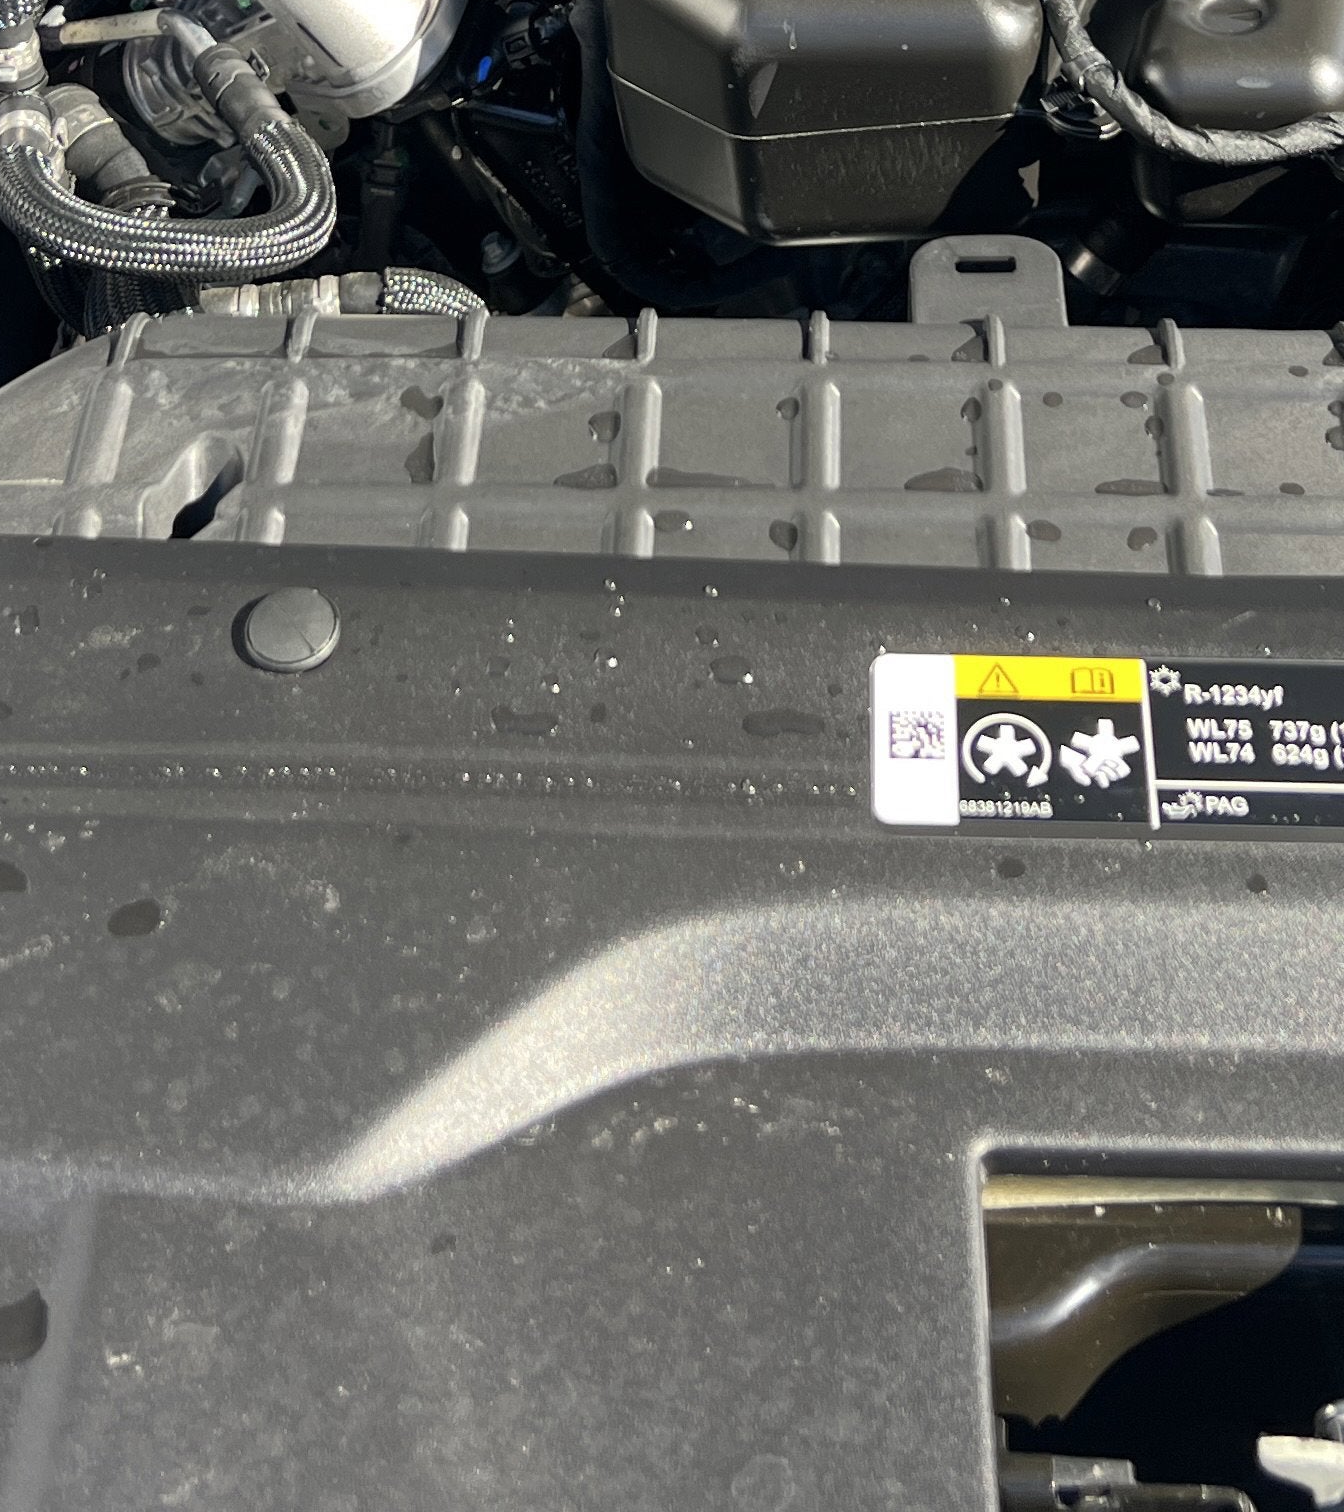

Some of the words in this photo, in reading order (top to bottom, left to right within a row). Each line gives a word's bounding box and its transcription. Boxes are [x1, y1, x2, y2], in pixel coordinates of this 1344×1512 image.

[1184, 683, 1285, 712] R-1234yf
[1186, 717, 1254, 741] WL75
[1268, 719, 1327, 746] 737g
[1188, 741, 1256, 766] WL74
[1271, 743, 1330, 771] 624g
[1205, 795, 1250, 818] PAG
